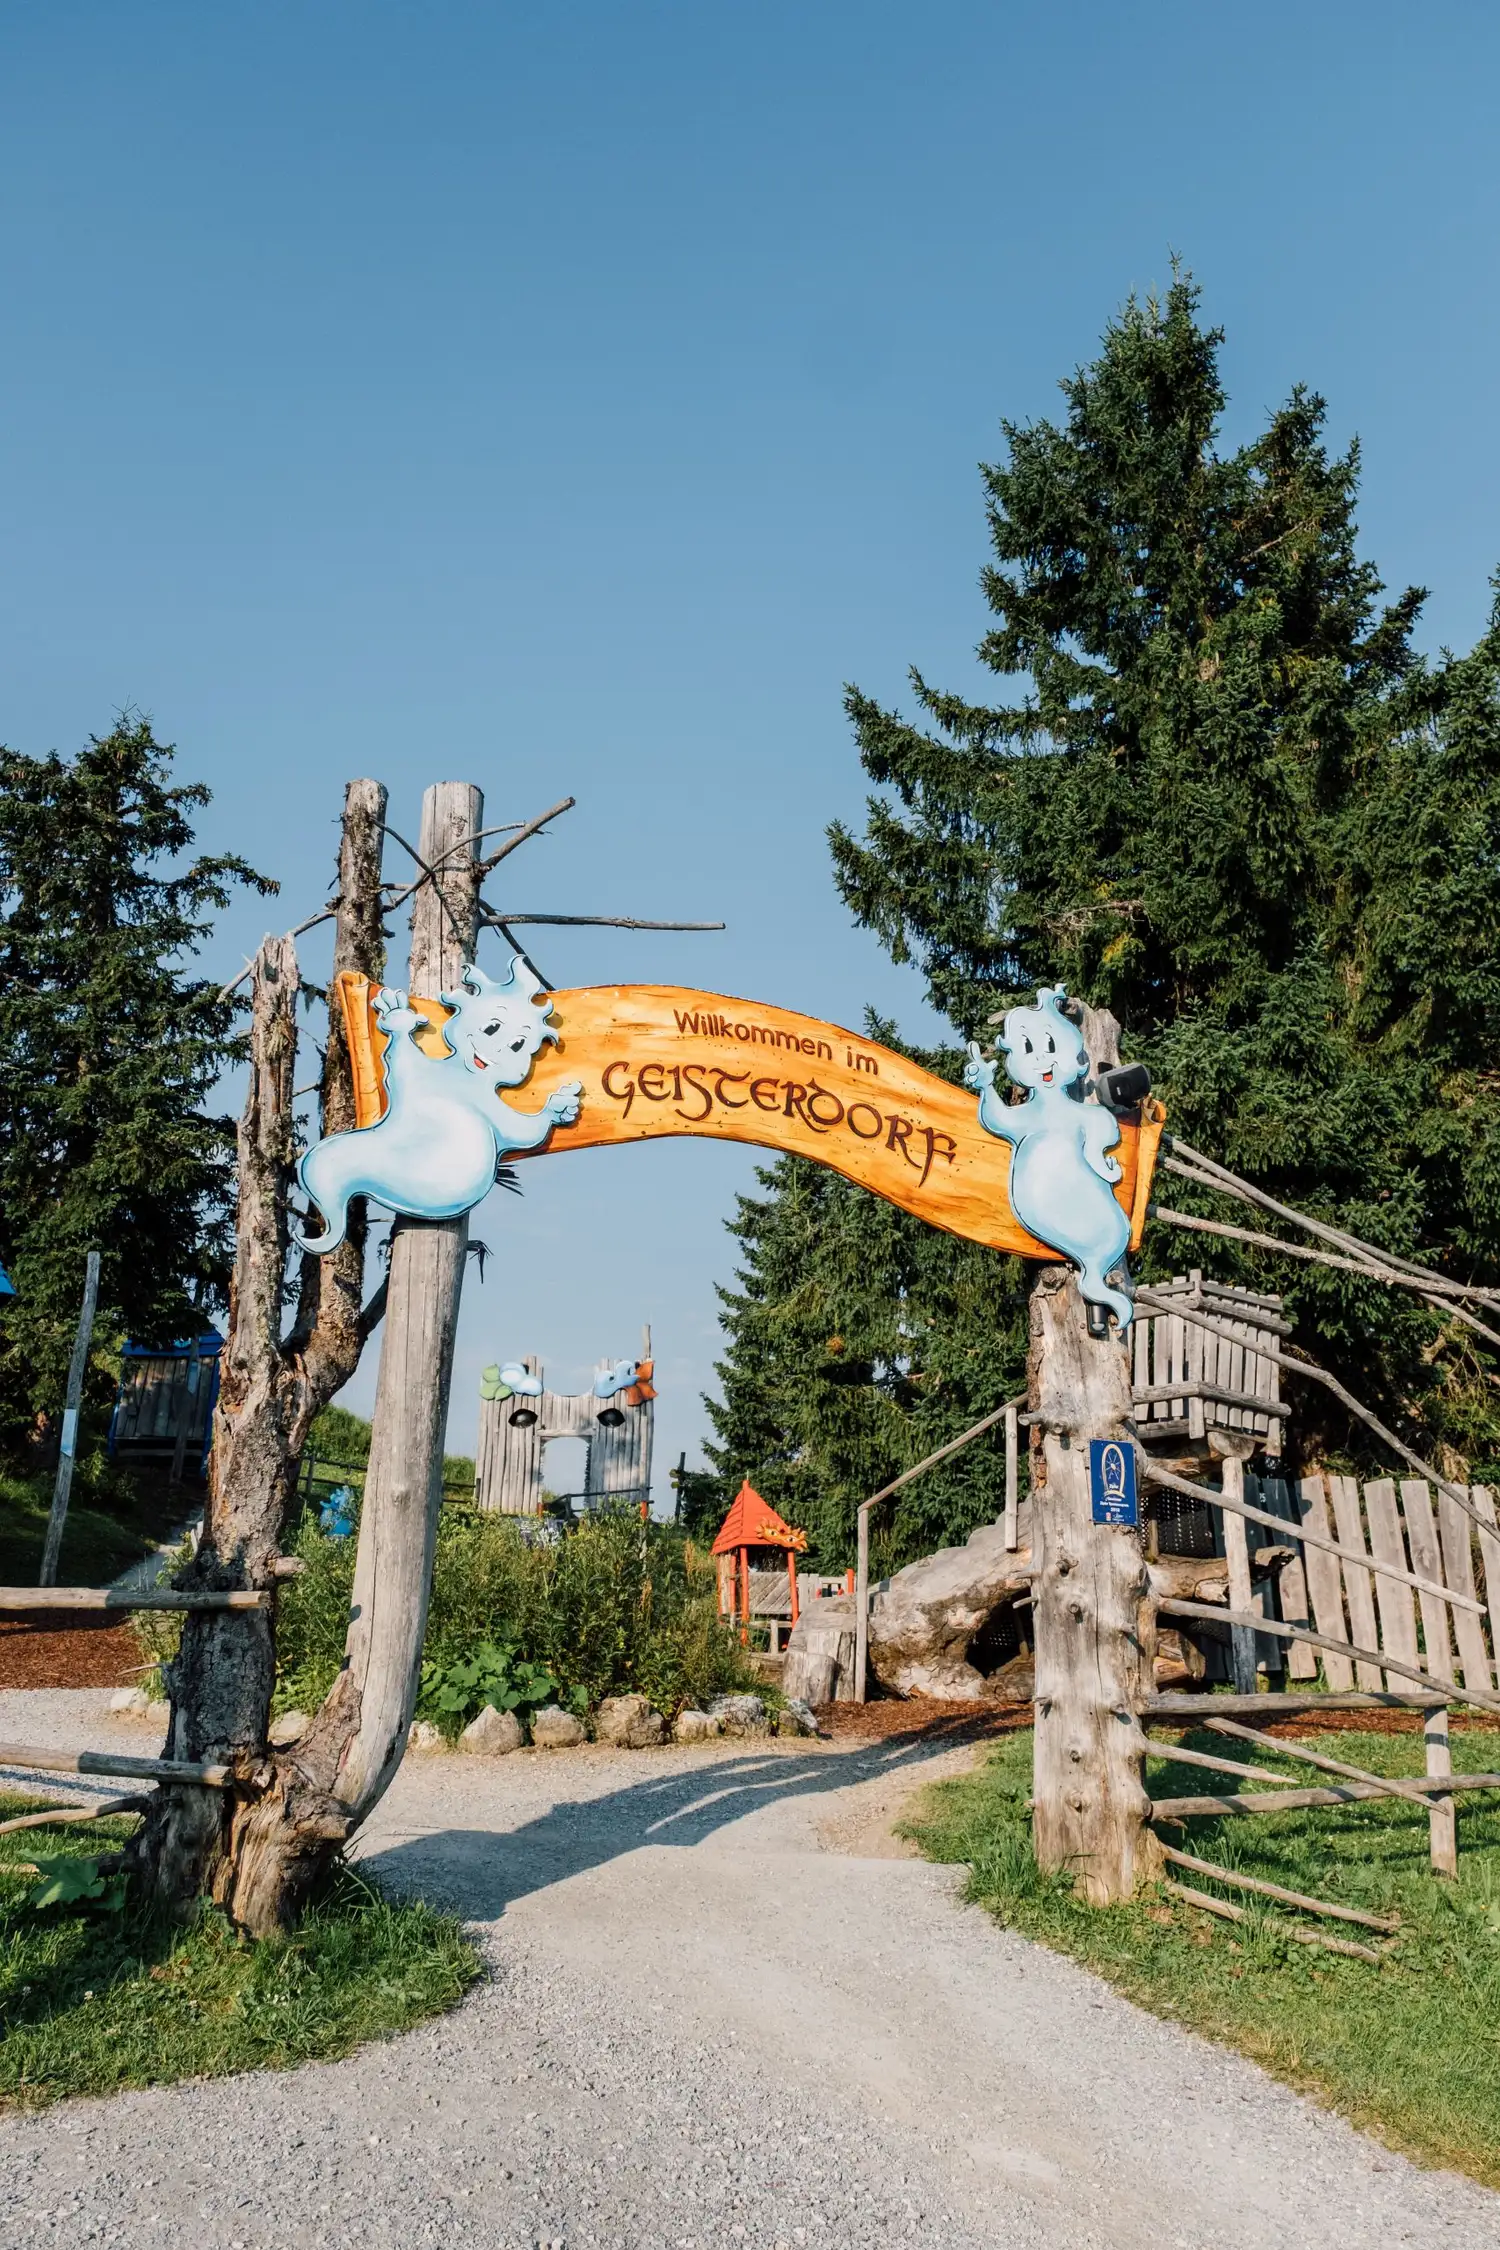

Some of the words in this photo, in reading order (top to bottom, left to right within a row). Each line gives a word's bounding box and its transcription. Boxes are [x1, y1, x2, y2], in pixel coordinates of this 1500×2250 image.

[672, 1008, 833, 1061] Willkommen
[846, 1045, 879, 1076] im
[601, 1060, 958, 1188] GEISTERDORF
